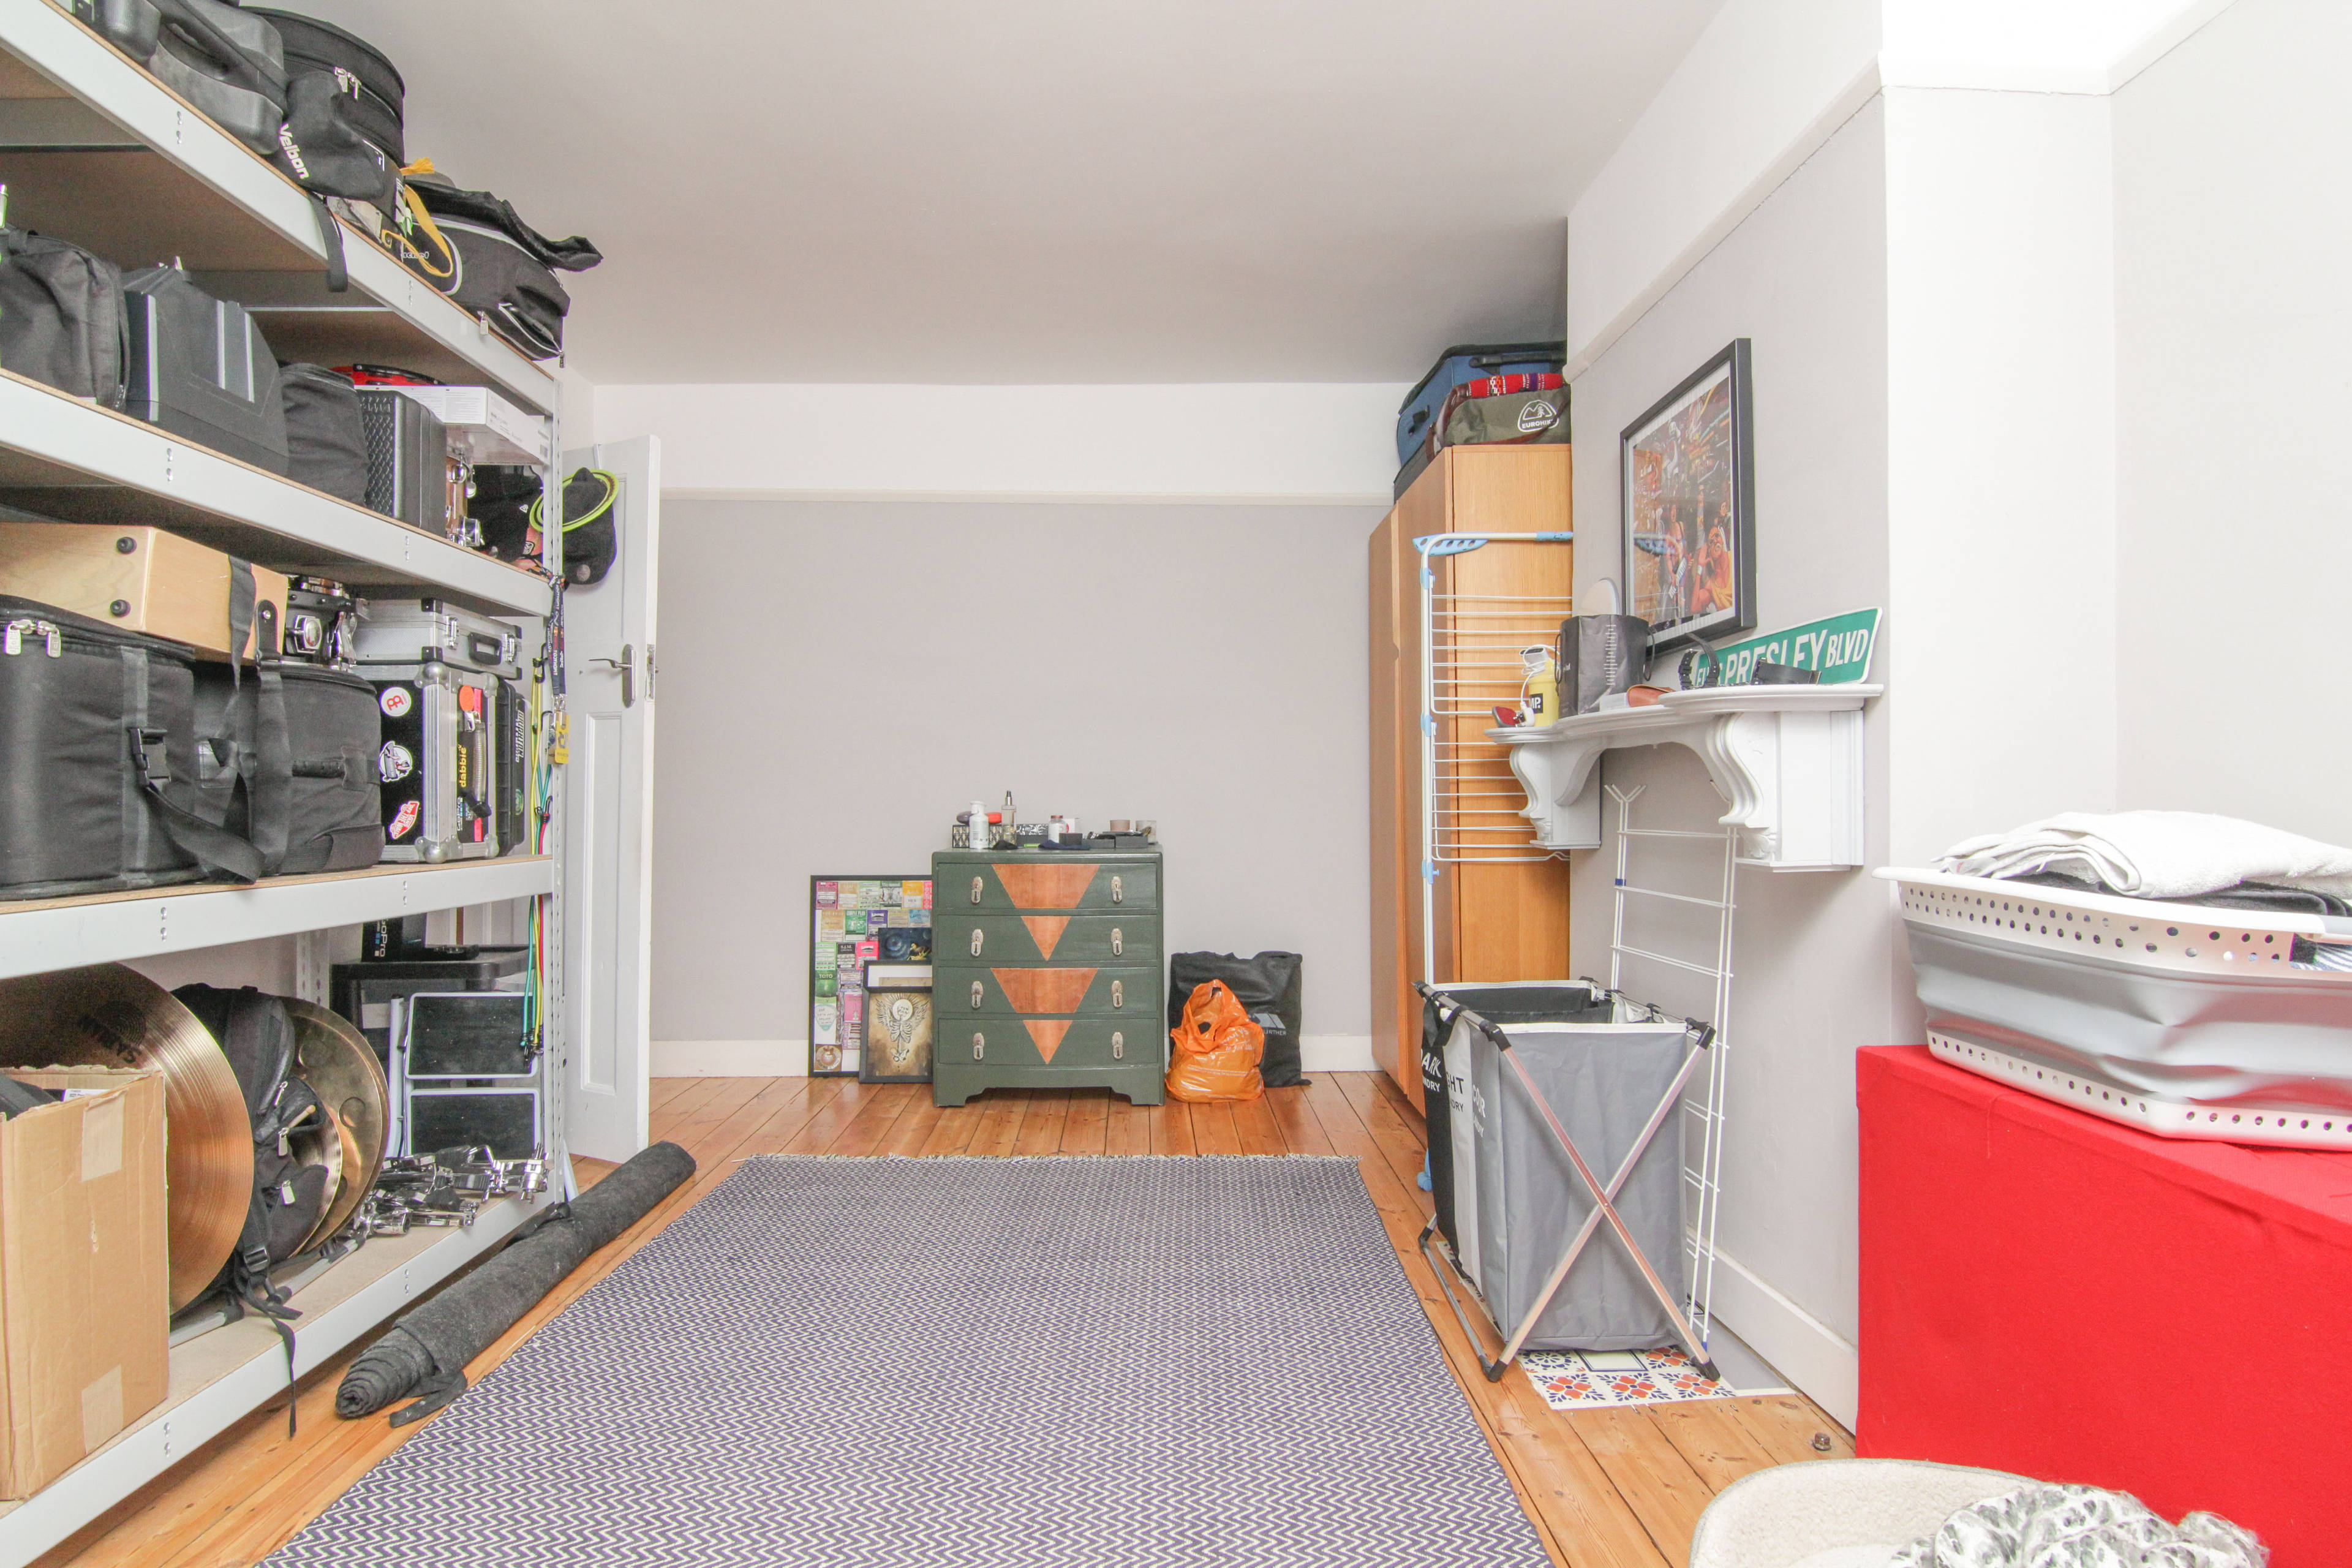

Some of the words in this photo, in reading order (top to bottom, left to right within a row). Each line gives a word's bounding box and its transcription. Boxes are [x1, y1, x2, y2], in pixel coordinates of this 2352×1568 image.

[279, 123, 309, 179] Velbon
[1522, 419, 1553, 428] EUROHIK
[1825, 629, 1869, 668] BLVD
